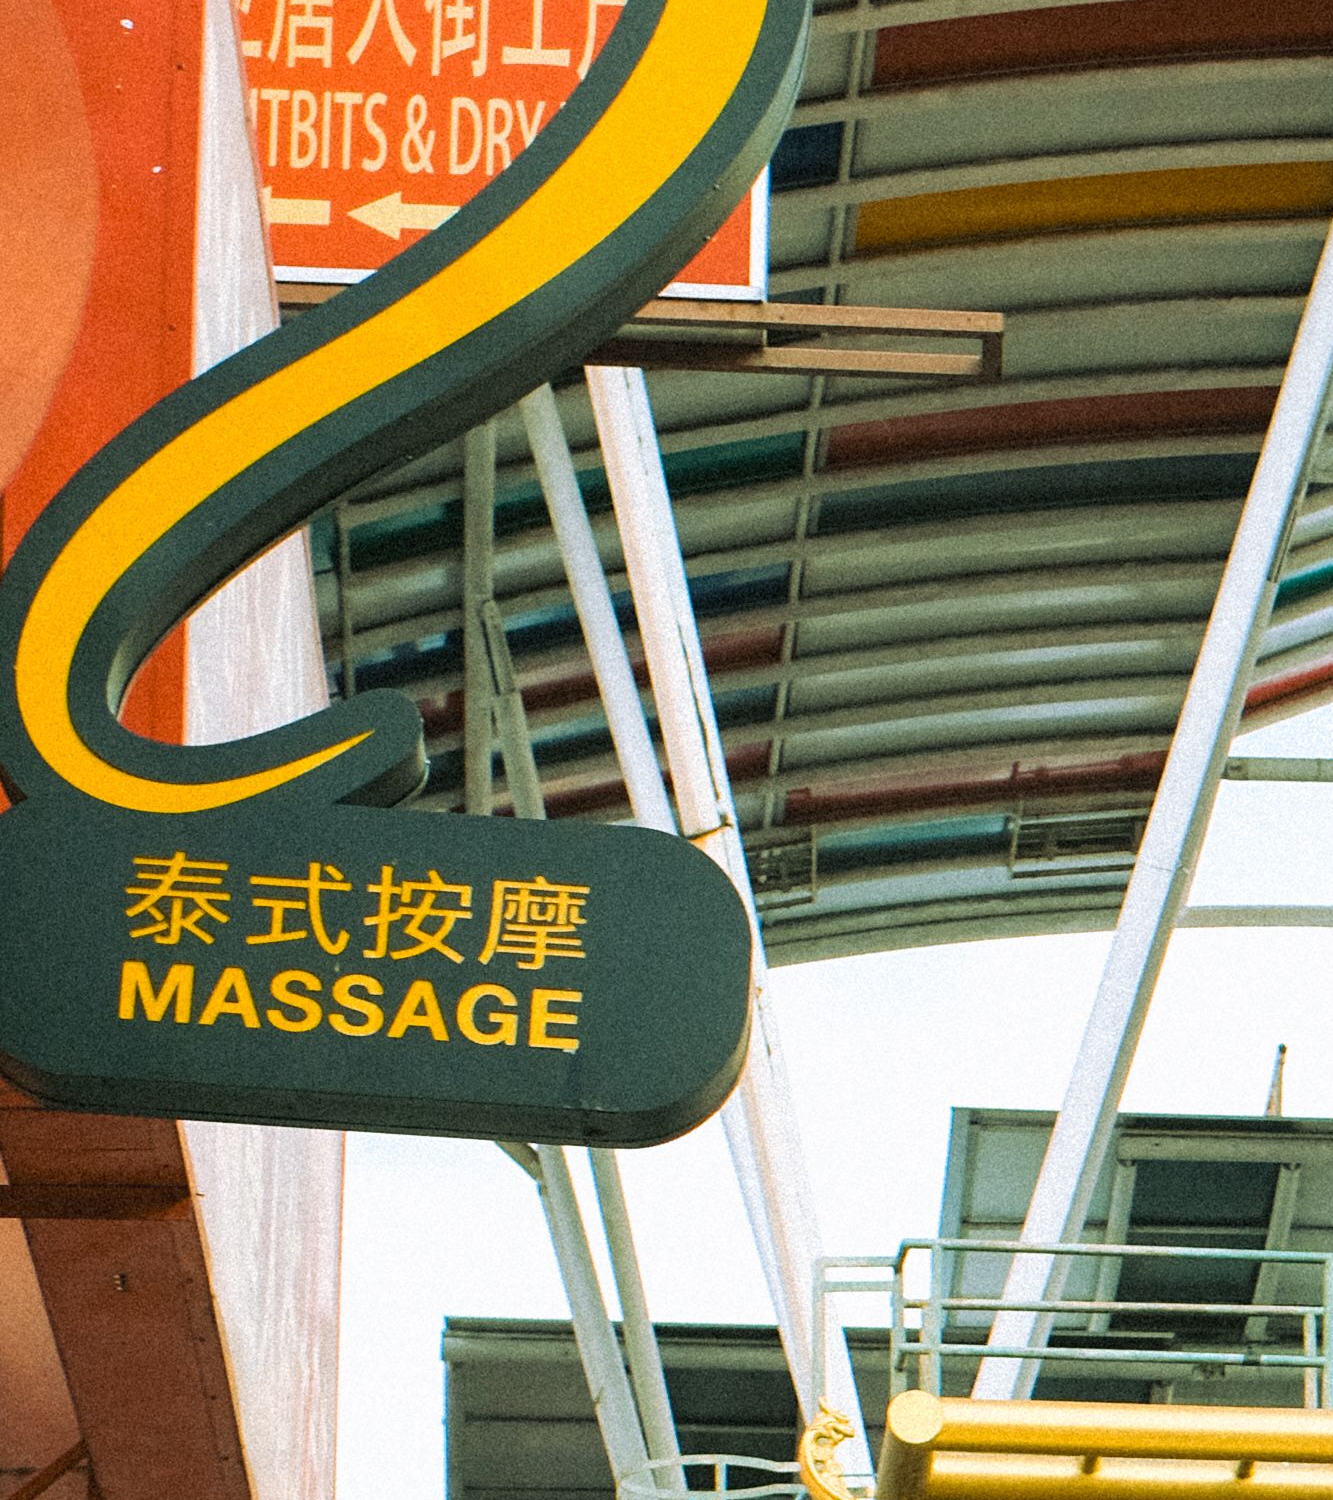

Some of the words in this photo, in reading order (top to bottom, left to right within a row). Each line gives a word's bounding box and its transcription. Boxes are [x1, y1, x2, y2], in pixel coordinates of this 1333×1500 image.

[402, 93, 436, 175] &
[124, 852, 591, 973] 泰式按摩
[117, 961, 584, 1054] MASSAGE
